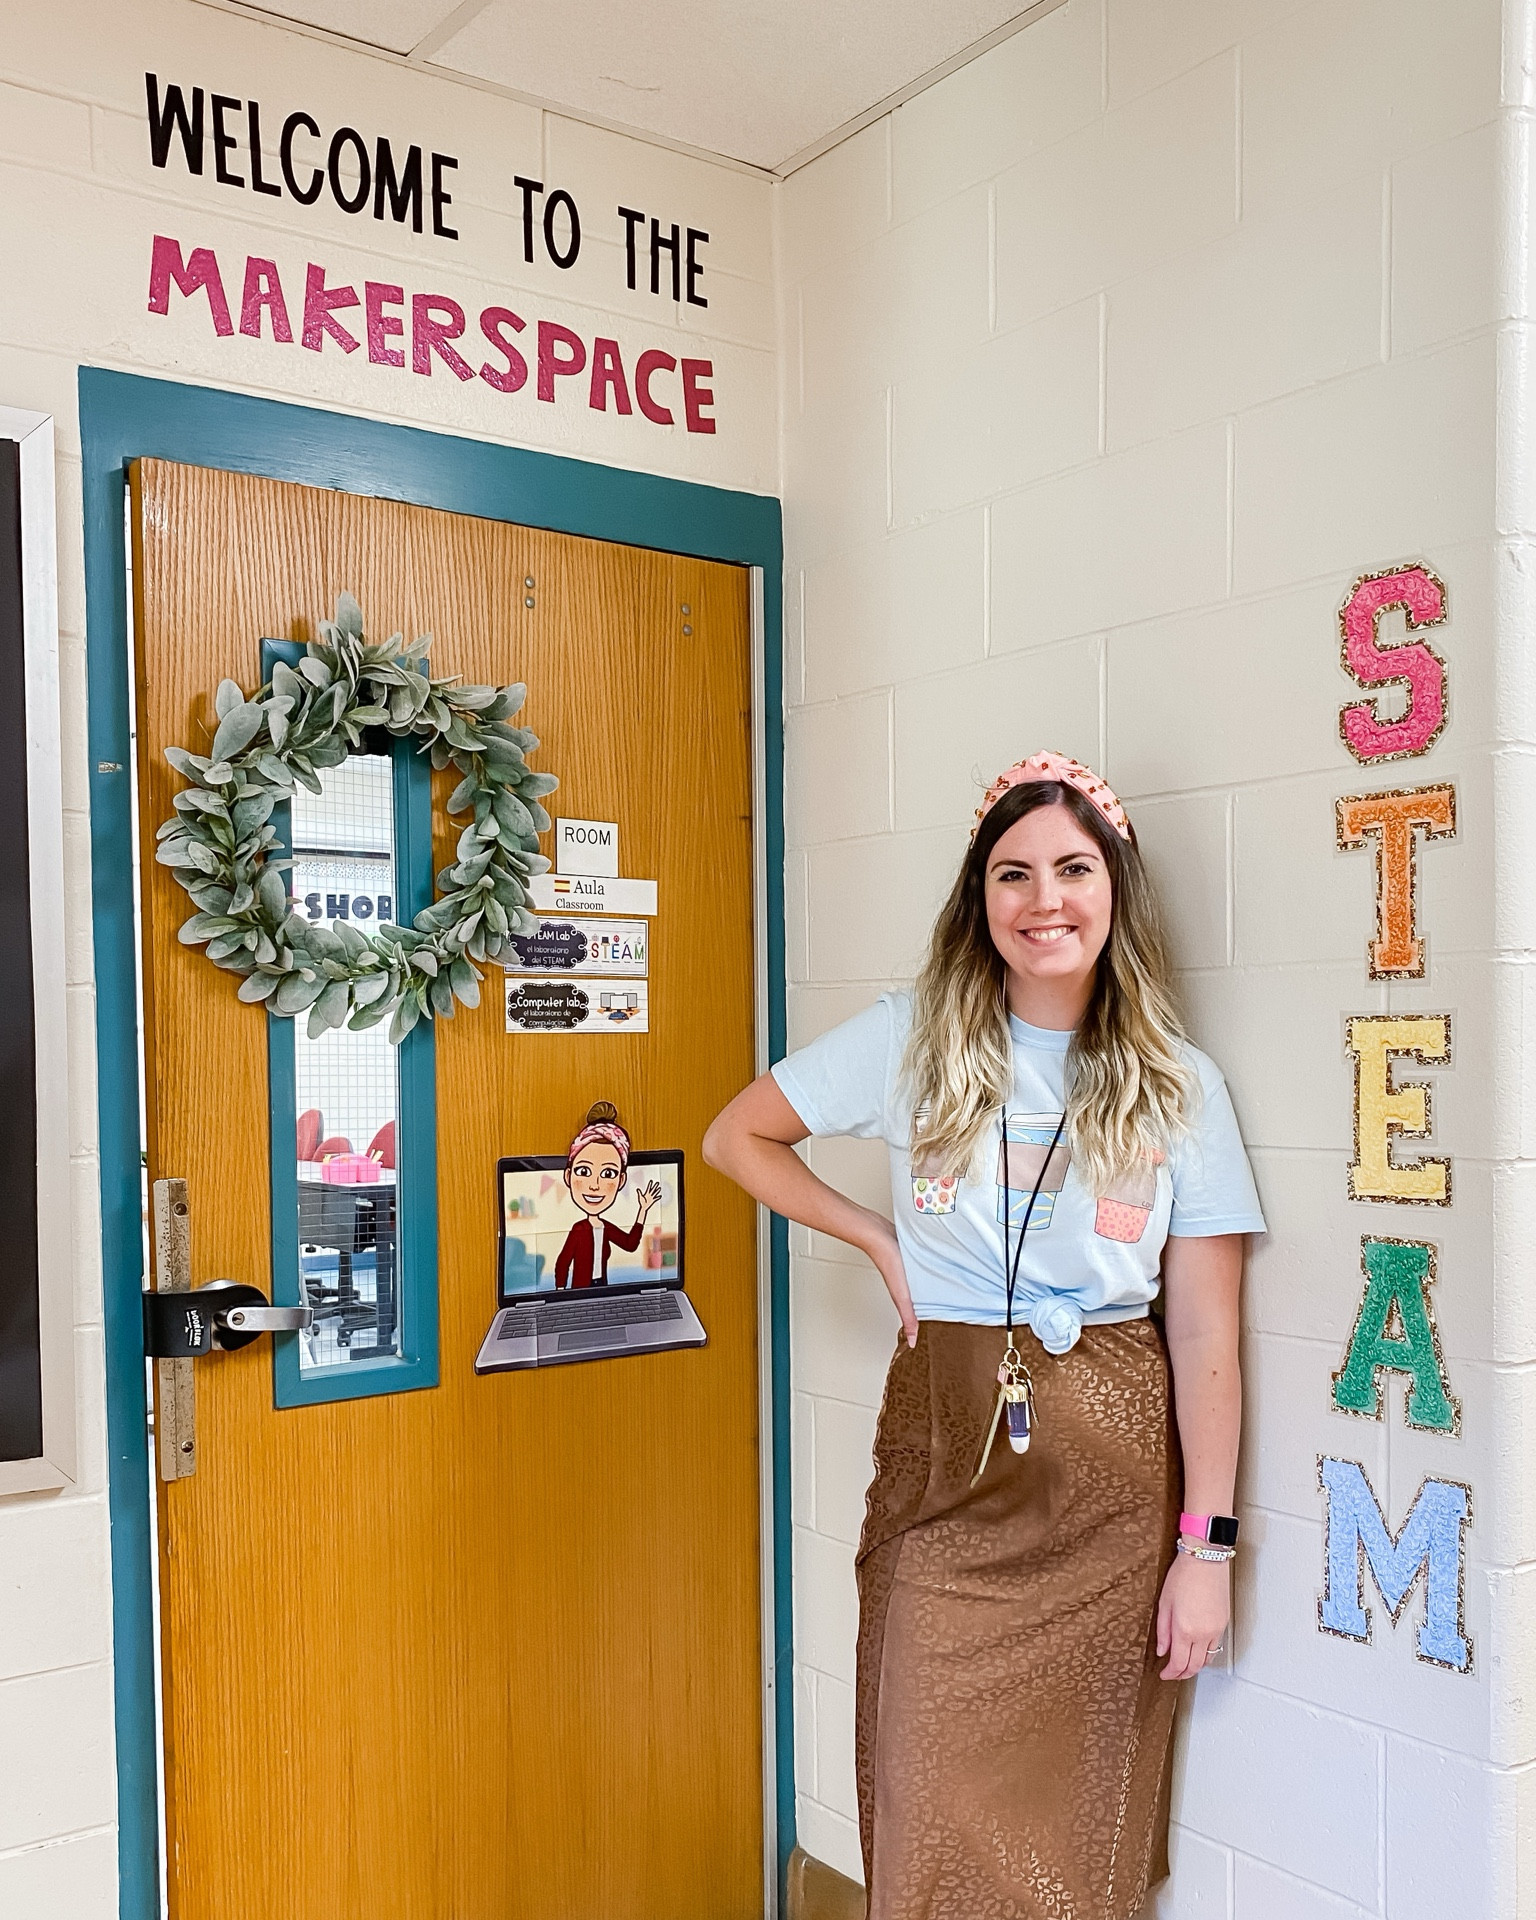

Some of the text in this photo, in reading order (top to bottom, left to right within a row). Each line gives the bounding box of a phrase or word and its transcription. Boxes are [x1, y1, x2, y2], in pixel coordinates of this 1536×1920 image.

[145, 72, 710, 309] WELCOME TO THE
[147, 234, 717, 435] MAKERSPACE
[564, 827, 611, 846] ROOM
[573, 880, 605, 896] Aula
[555, 898, 604, 911] Classroom
[591, 942, 644, 960] STEAM
[543, 956, 565, 965] STEAM
[516, 996, 580, 1010] Computer lab
